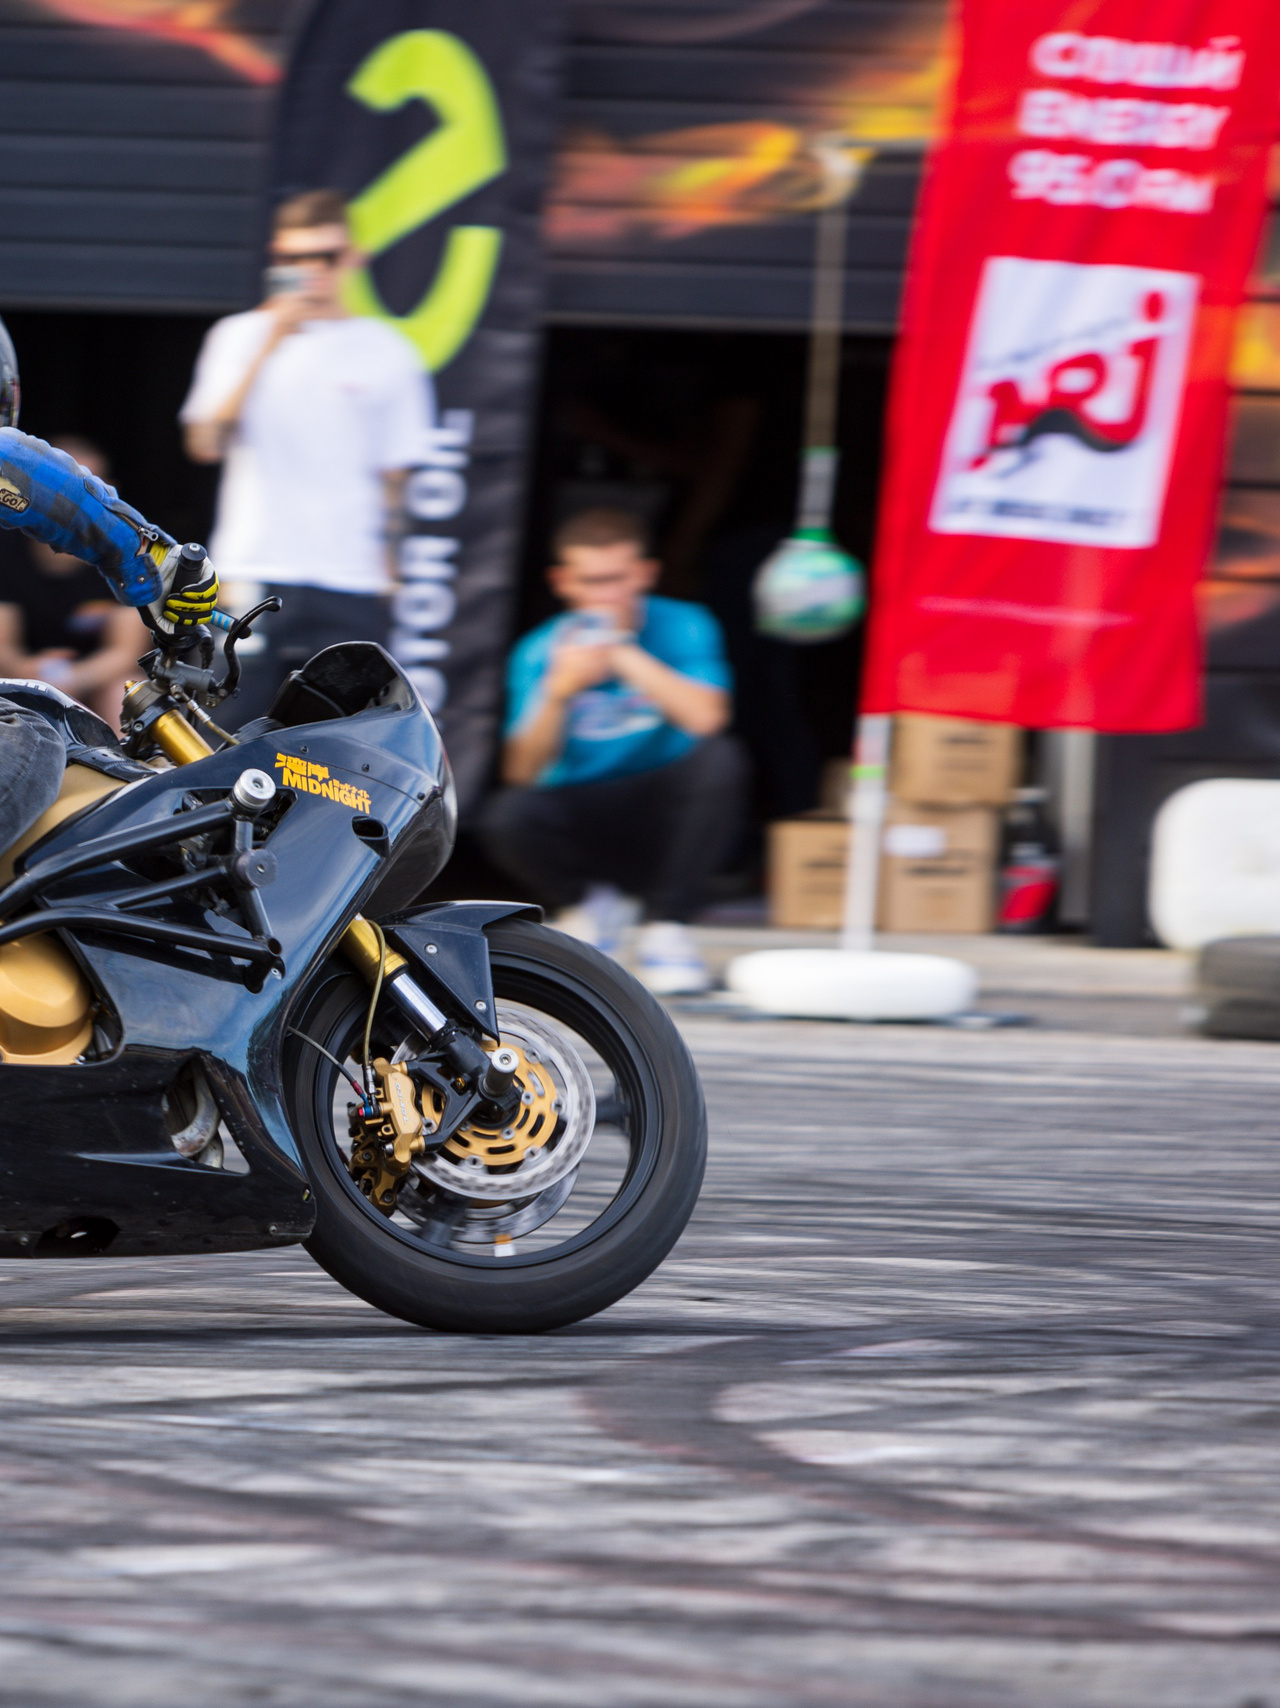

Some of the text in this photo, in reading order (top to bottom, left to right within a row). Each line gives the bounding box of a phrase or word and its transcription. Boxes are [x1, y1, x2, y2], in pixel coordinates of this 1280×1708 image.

[1019, 89, 1231, 151] ENERGY
[2, 493, 24, 509] Go!
[387, 407, 475, 733] OTOR OIL
[282, 768, 372, 814] MIDNIGHT
[395, 1081, 409, 1124] TOKICO
